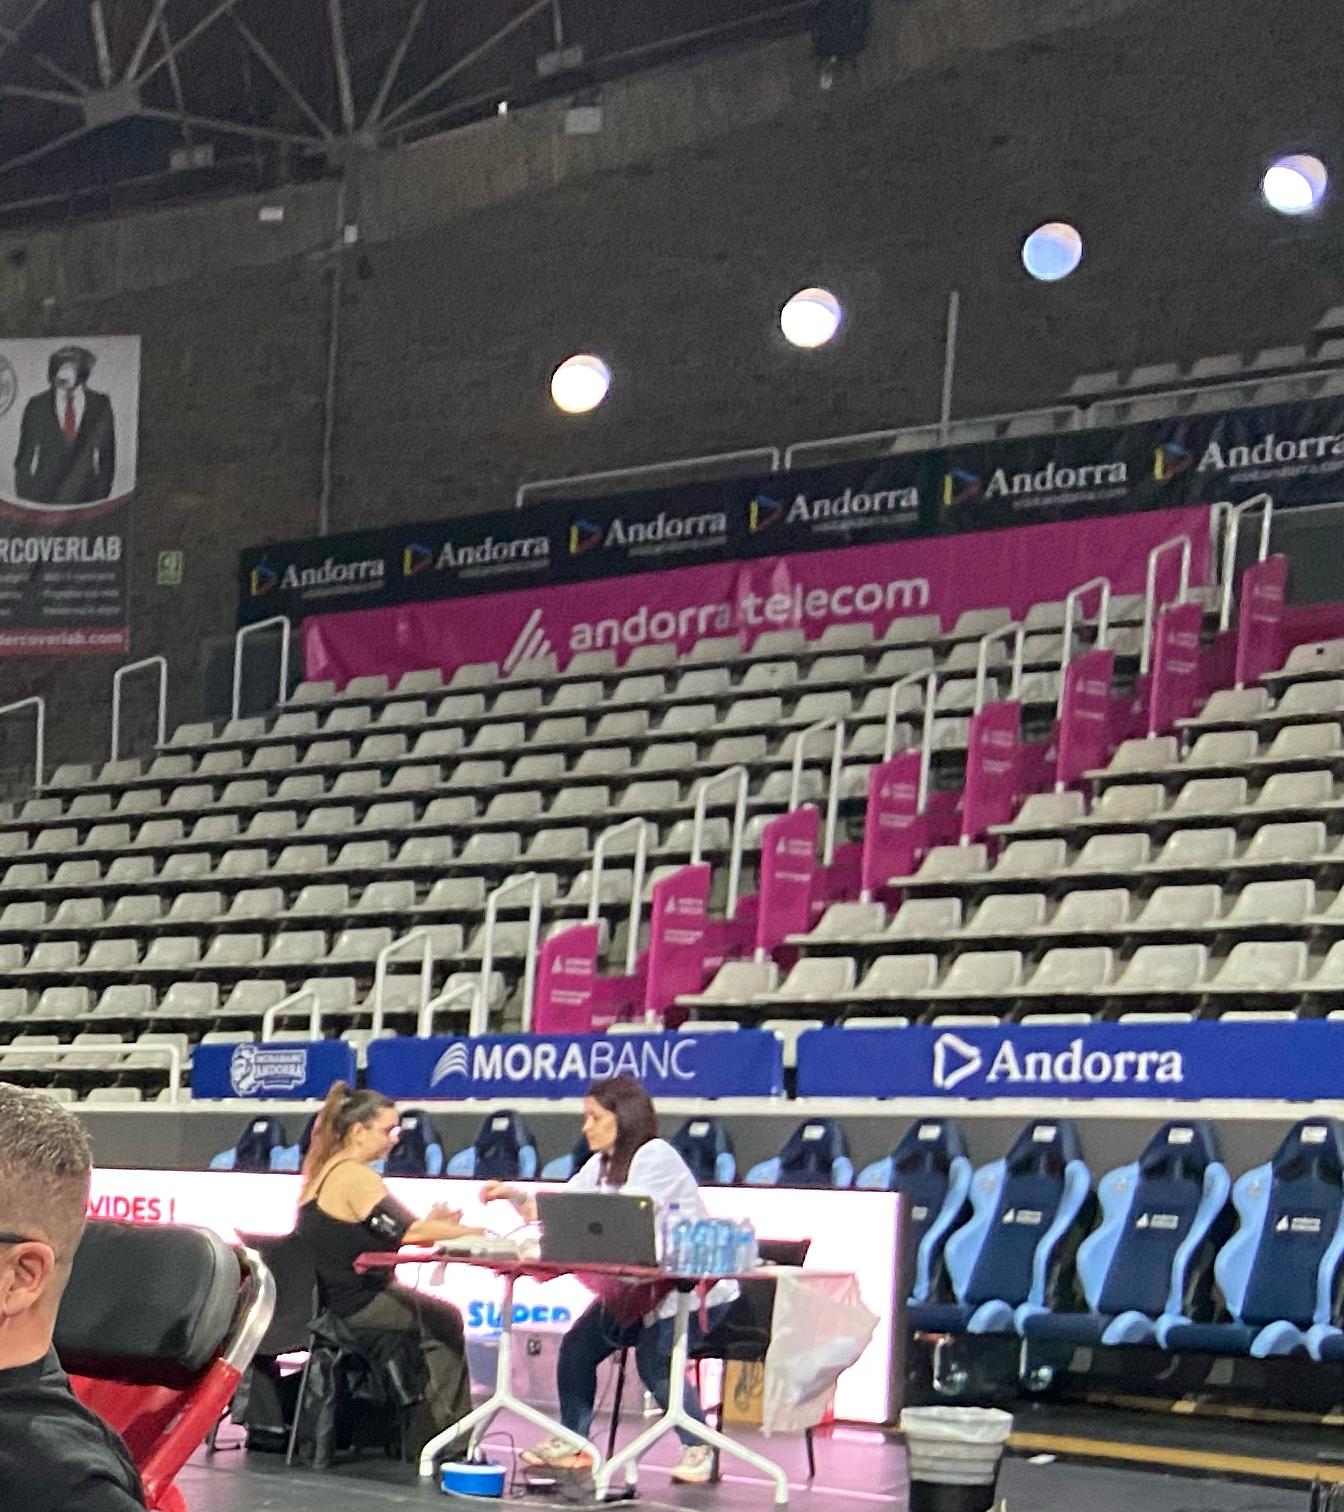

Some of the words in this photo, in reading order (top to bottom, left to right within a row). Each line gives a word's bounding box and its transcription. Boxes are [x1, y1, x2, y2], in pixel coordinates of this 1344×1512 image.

[984, 460, 1127, 497] Andorra
[786, 487, 919, 523] Andorra
[603, 511, 727, 547] Andorra
[436, 536, 551, 570] Andorra
[280, 557, 385, 589] Andorra
[569, 604, 732, 651] andorra
[742, 577, 931, 627] telecom
[472, 1039, 698, 1080] MORABANC
[985, 1039, 1185, 1083] Andorra
